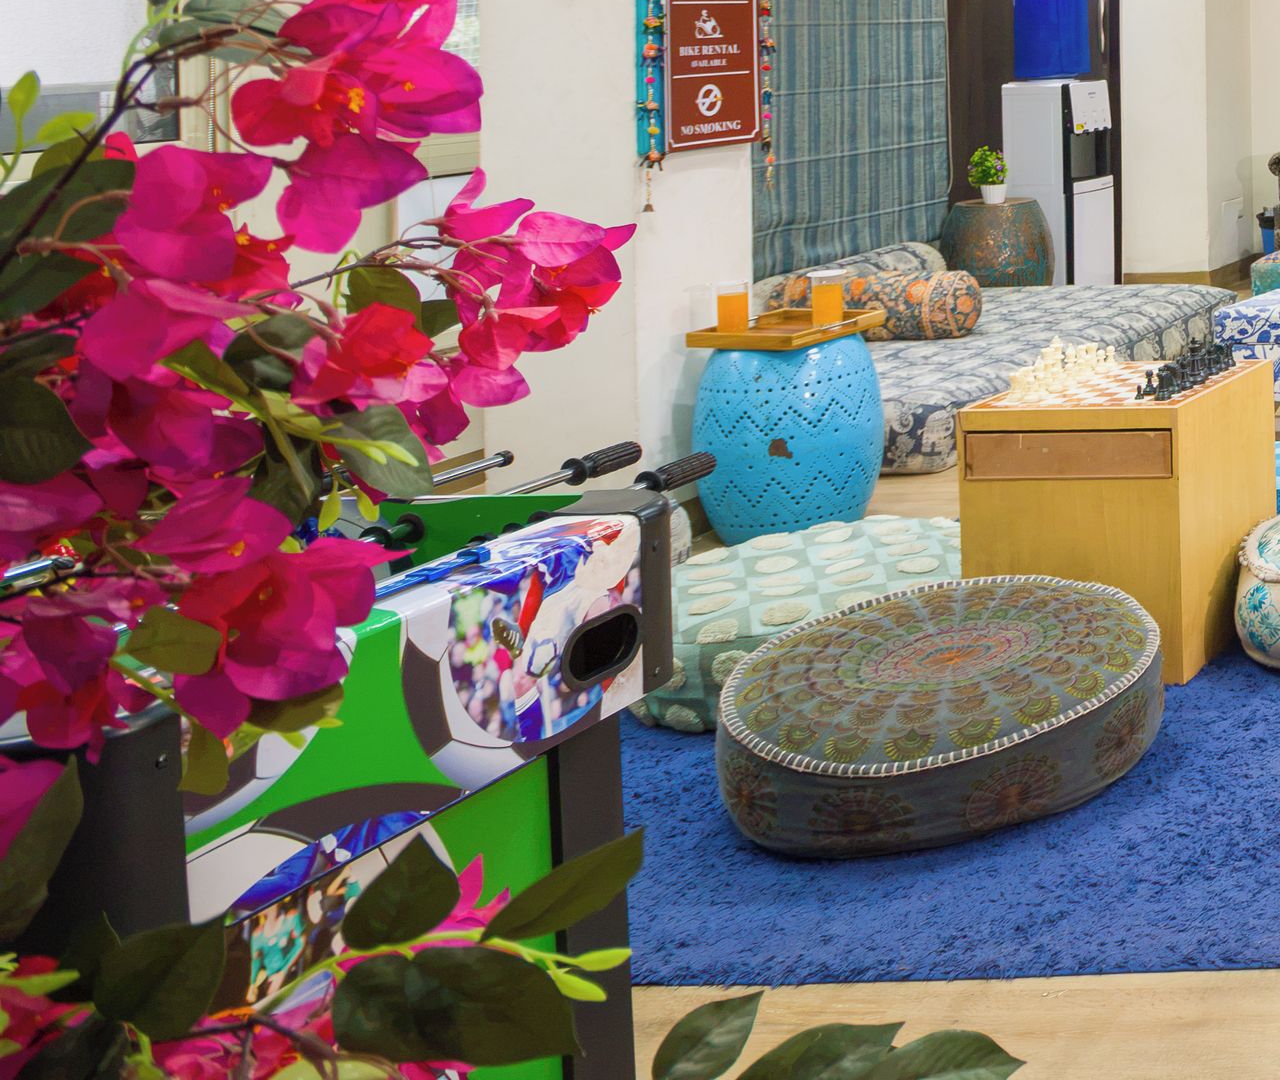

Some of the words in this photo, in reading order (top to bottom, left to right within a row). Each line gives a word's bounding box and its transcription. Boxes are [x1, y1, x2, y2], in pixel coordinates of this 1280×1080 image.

[679, 46, 700, 56] BIKE
[702, 44, 741, 55] RENTAL
[681, 125, 694, 136] NO
[694, 120, 742, 135] SMOKING
